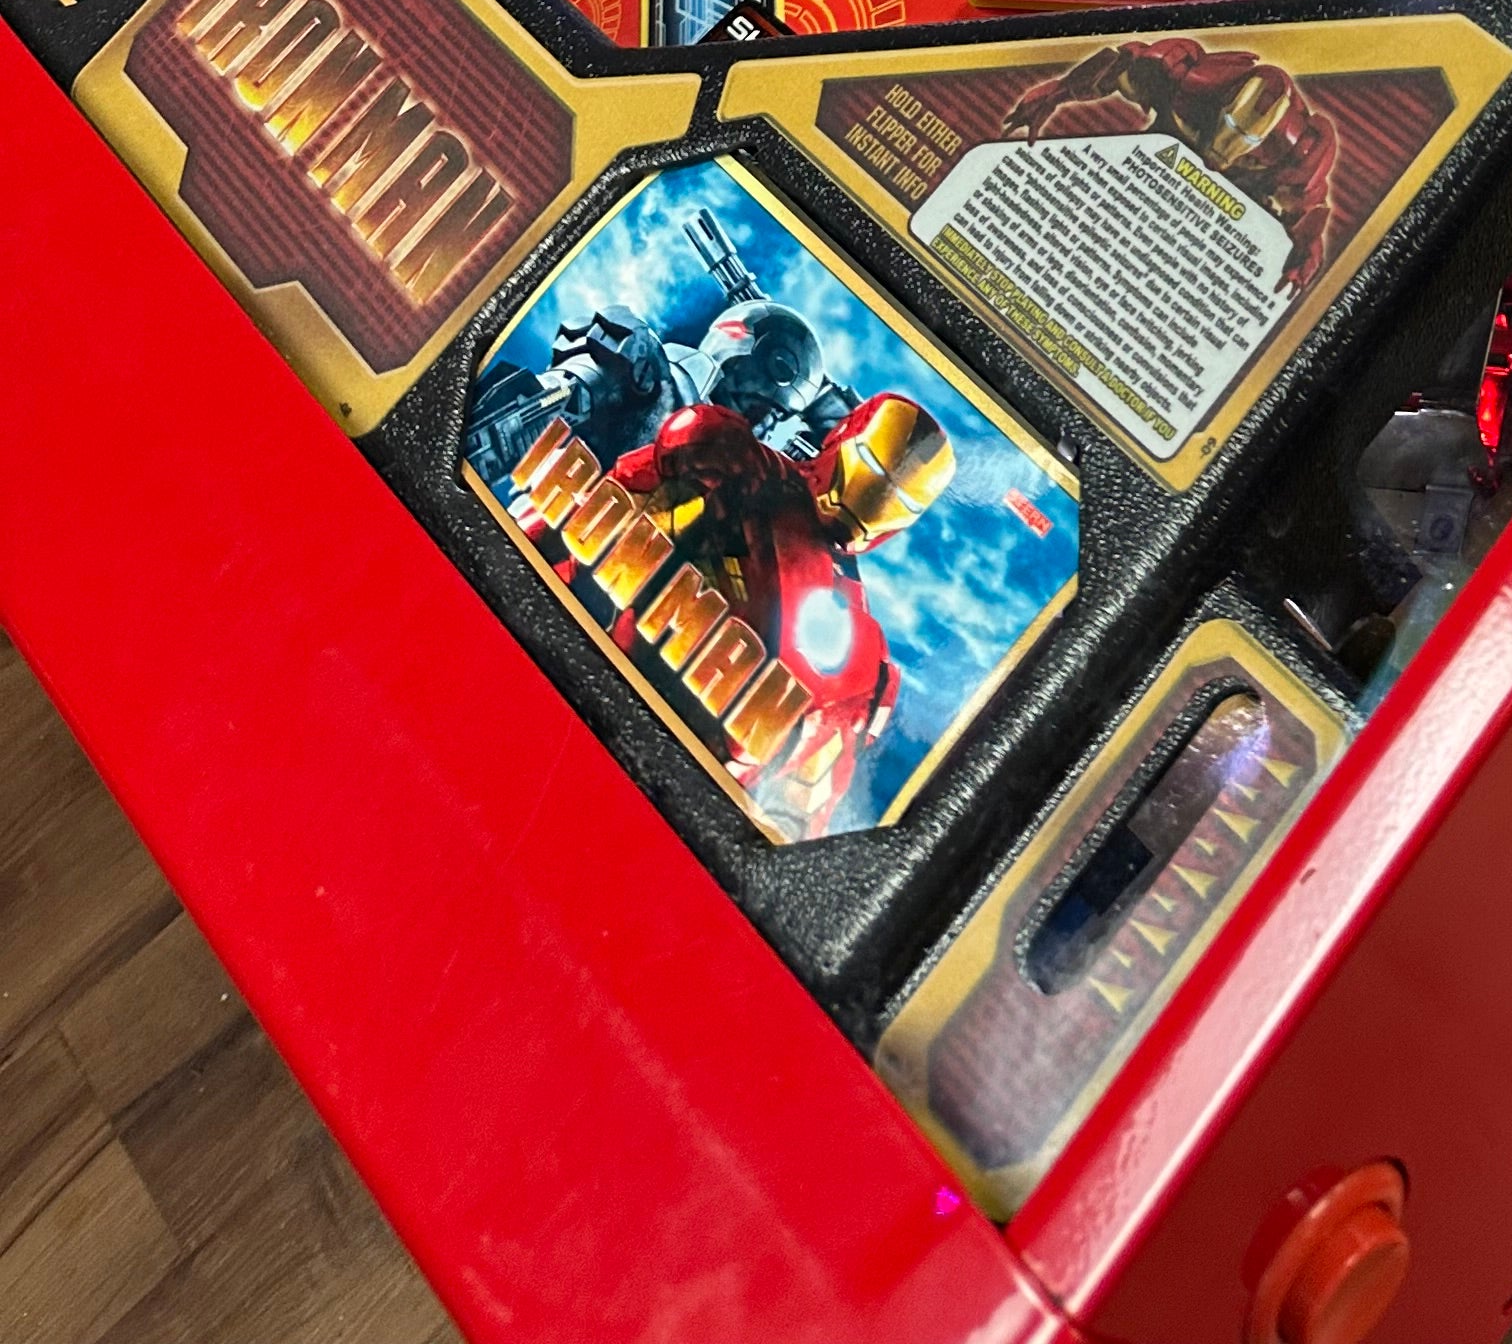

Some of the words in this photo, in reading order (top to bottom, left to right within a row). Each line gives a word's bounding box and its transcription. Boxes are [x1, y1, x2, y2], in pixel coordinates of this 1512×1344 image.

[843, 122, 901, 175] INSTANT
[891, 165, 929, 201] INFO
[865, 104, 918, 155] FLIPPER
[910, 143, 943, 178] FOR
[883, 82, 923, 120] HOLD
[914, 109, 964, 157] EITHER
[306, 74, 519, 310] MAN
[1037, 145, 1073, 179] flashing
[1066, 169, 1094, 196] lights
[1095, 194, 1137, 234] patterns.
[1130, 224, 1156, 249] Even
[1149, 240, 1183, 273] people
[1176, 263, 1201, 287] with
[1204, 288, 1240, 323] history
[1058, 142, 1090, 173] seizure
[1085, 165, 1111, 190] when
[1104, 182, 1142, 219] exposed
[1145, 216, 1180, 249] certain
[1174, 240, 1203, 268] visual
[1196, 260, 1234, 297] images,
[1227, 287, 1270, 328] including
[1086, 148, 1109, 170] very
[1104, 162, 1131, 187] small
[1124, 178, 1173, 225] percentage
[1176, 223, 1209, 255] people
[1202, 247, 1225, 270] may
[1220, 260, 1270, 306] experience
[1120, 154, 1213, 235] PHOTOSENSITIVE
[1207, 228, 1265, 279] SEIZURES
[1130, 144, 1184, 190] Important
[1178, 184, 1218, 219] Health
[1213, 213, 1264, 258] Warning:
[1172, 155, 1248, 222] WARNING
[510, 414, 676, 611] IRON
[634, 559, 816, 768] MAN
